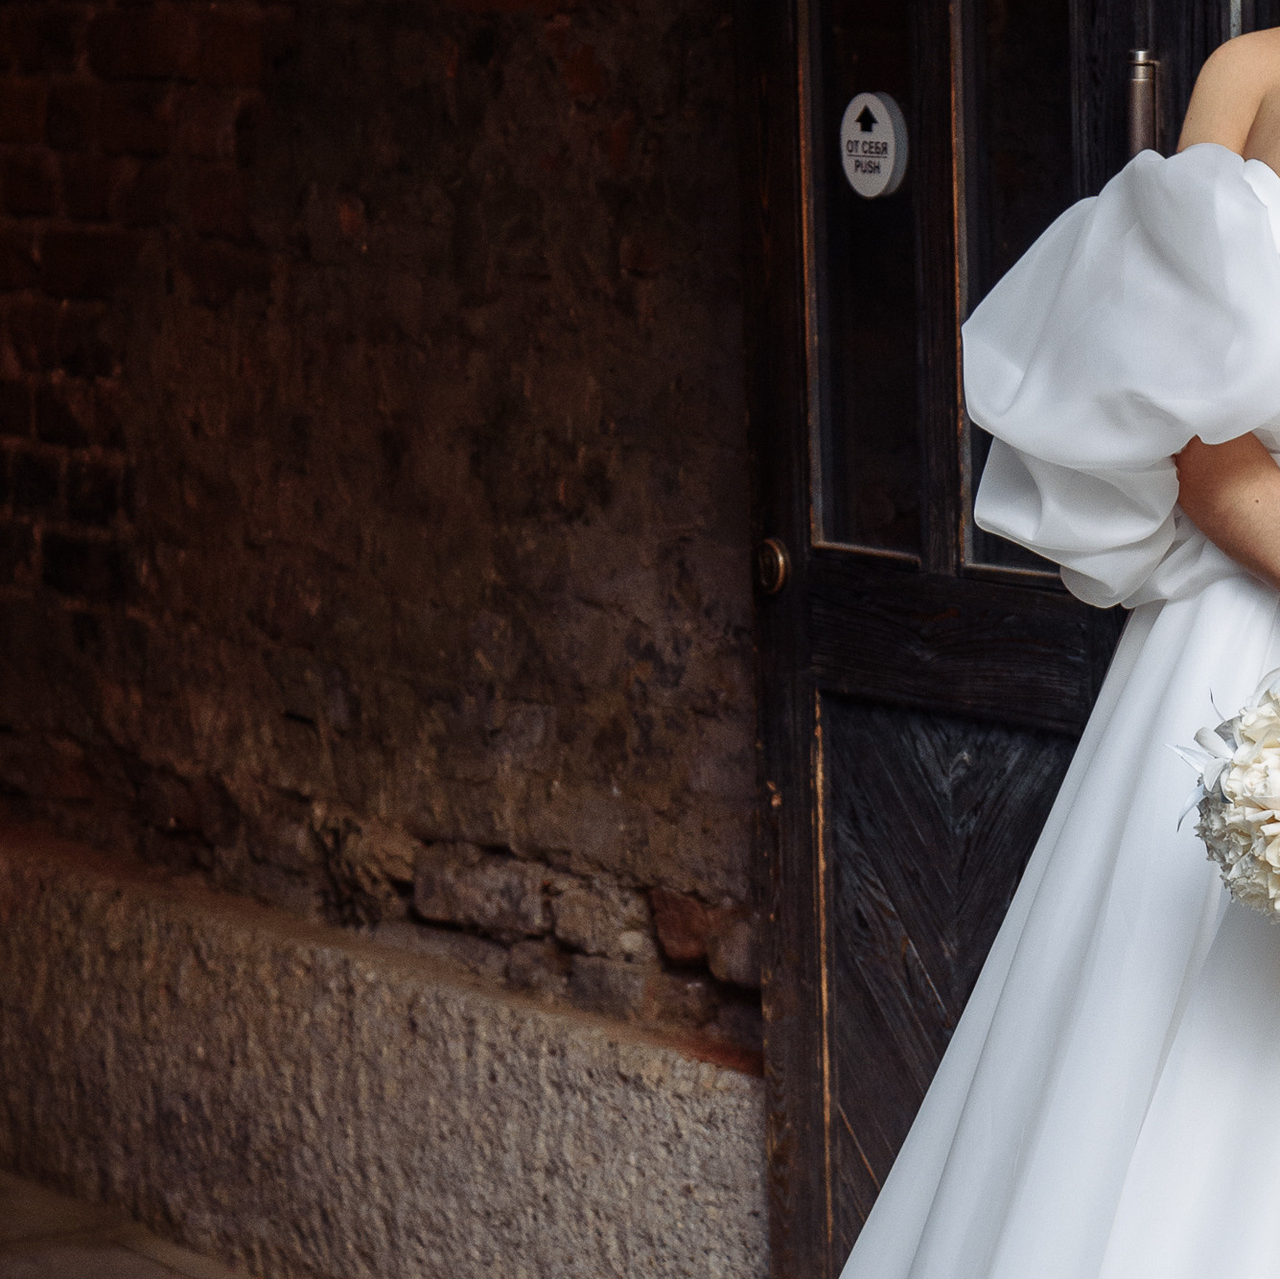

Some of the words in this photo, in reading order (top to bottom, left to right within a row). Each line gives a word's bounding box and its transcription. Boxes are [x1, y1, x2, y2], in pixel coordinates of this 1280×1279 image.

[846, 139, 859, 153] ОТ
[862, 140, 888, 154] СЕБЯ
[855, 159, 880, 174] PUSH
